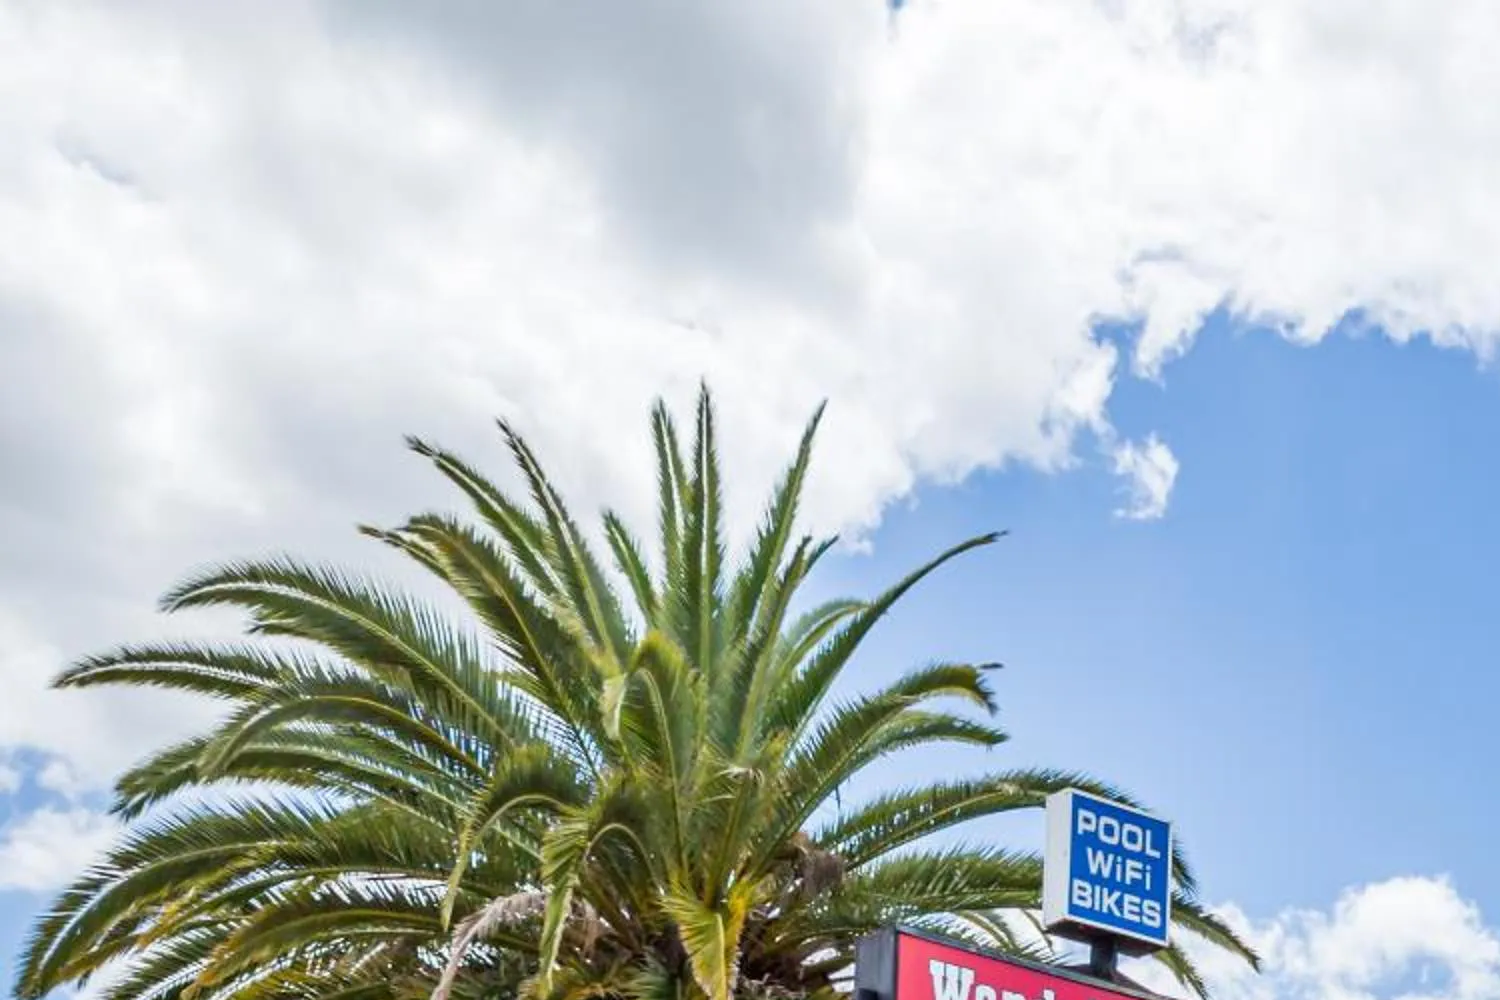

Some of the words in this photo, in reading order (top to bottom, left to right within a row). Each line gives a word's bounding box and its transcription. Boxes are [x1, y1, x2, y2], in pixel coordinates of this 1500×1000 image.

[1076, 808, 1161, 859] POOL
[1086, 847, 1152, 891] WiFi
[1071, 878, 1162, 928] BIKES
